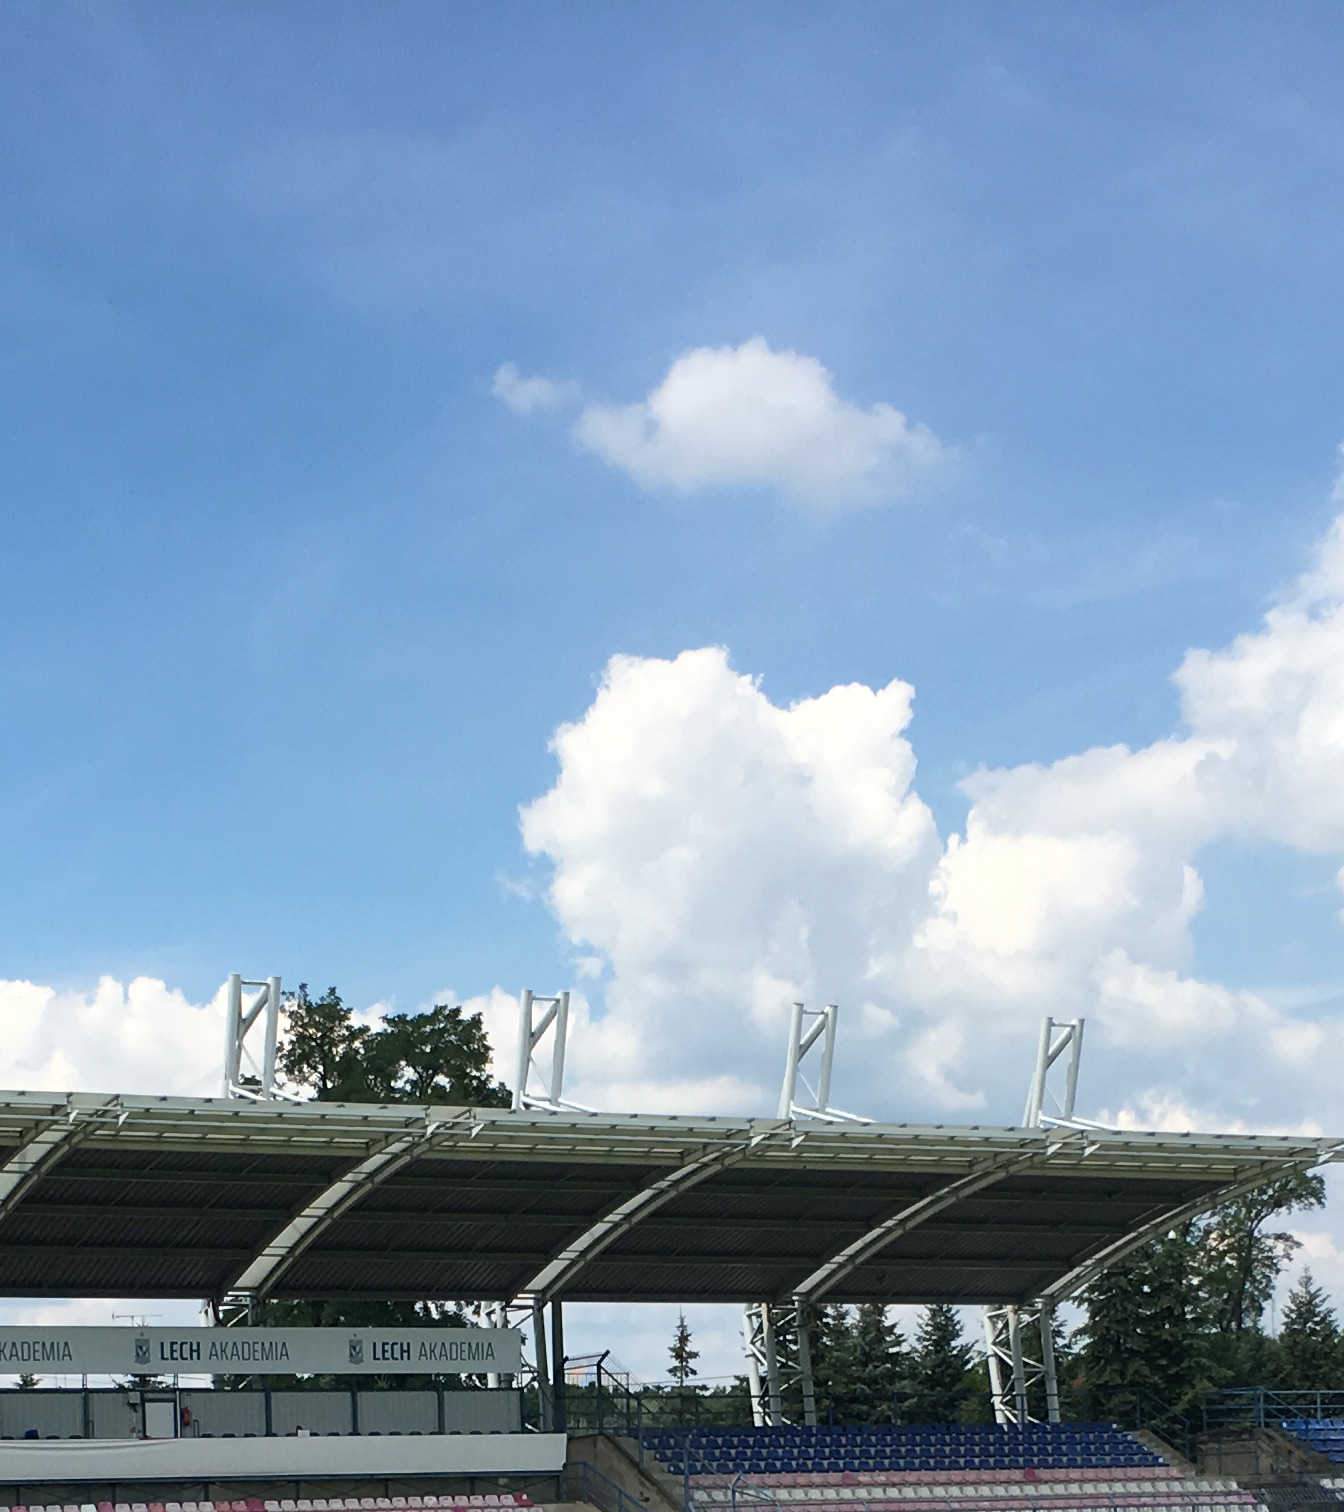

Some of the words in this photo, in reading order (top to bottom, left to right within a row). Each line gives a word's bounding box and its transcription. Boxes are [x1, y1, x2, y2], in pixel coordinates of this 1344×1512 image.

[160, 1341, 201, 1361] LECH
[208, 1341, 290, 1361] AKADEMIA
[372, 1341, 411, 1361] LECH
[418, 1341, 495, 1361] AKADEMIA
